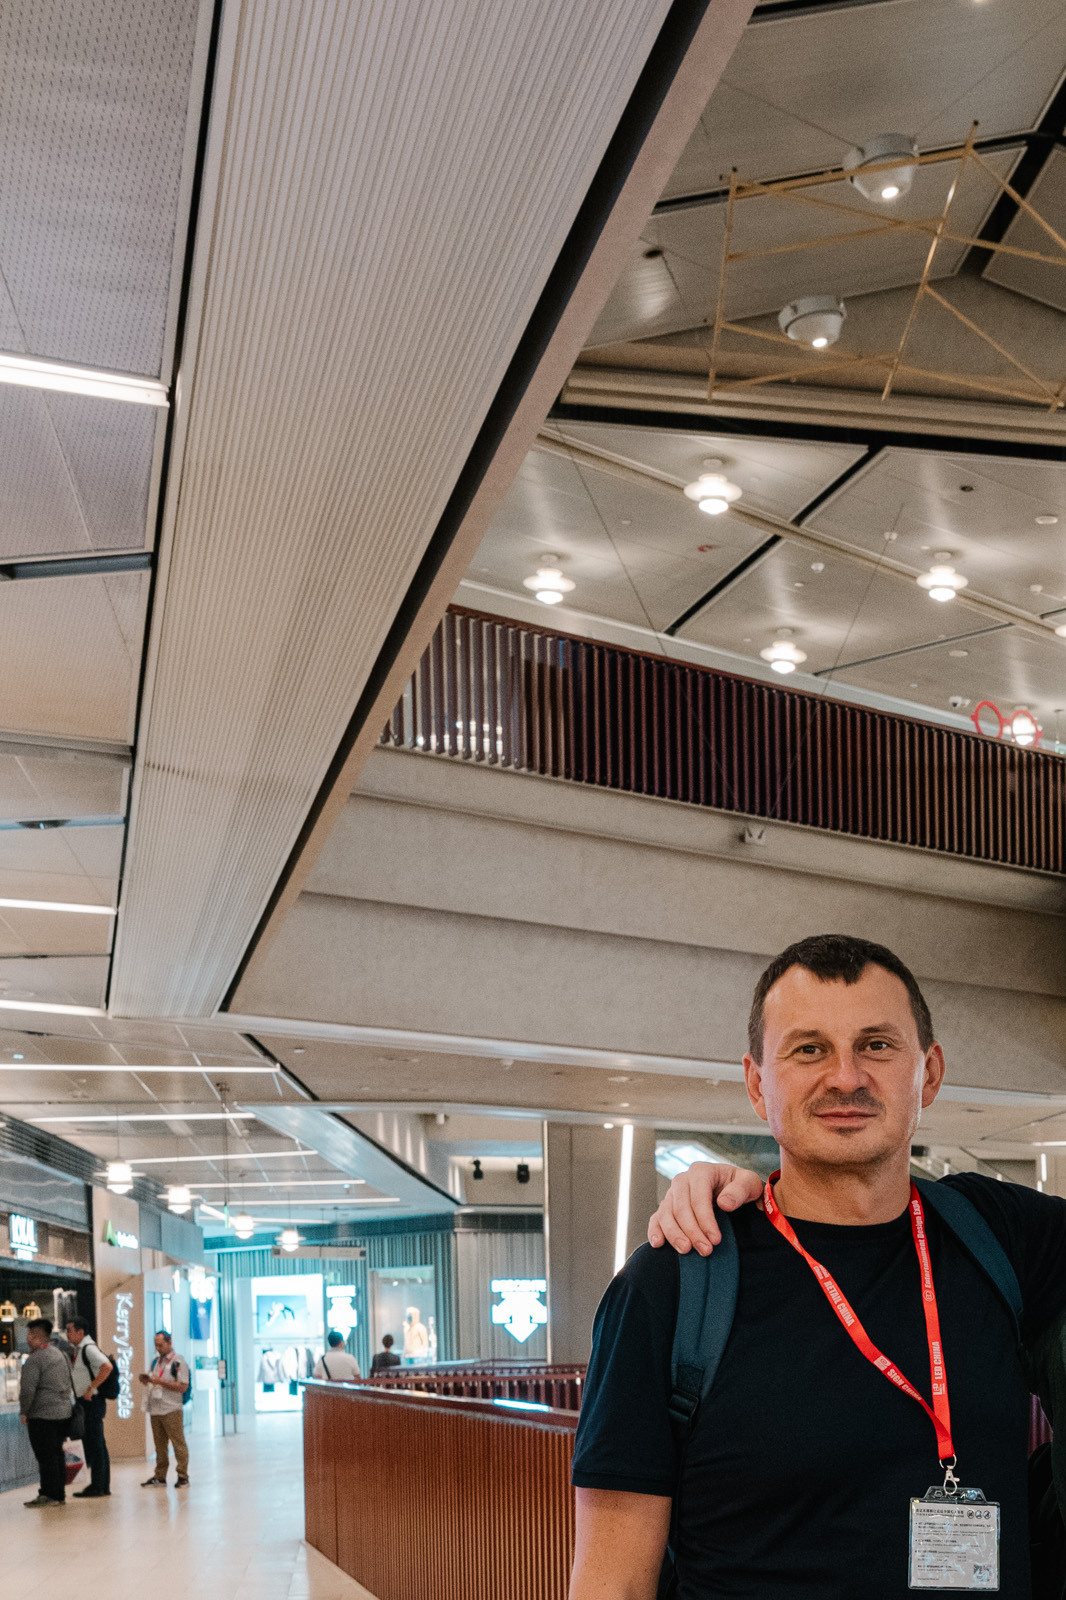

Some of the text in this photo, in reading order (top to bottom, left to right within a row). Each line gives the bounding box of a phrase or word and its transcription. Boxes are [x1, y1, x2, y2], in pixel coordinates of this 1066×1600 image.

[915, 1215, 925, 1239] Design
[918, 1239, 932, 1288] Entertainment
[823, 1280, 855, 1327] RETAIL CHINA
[886, 1368, 905, 1386] SIGN
[931, 1341, 943, 1380] LED CHINA
